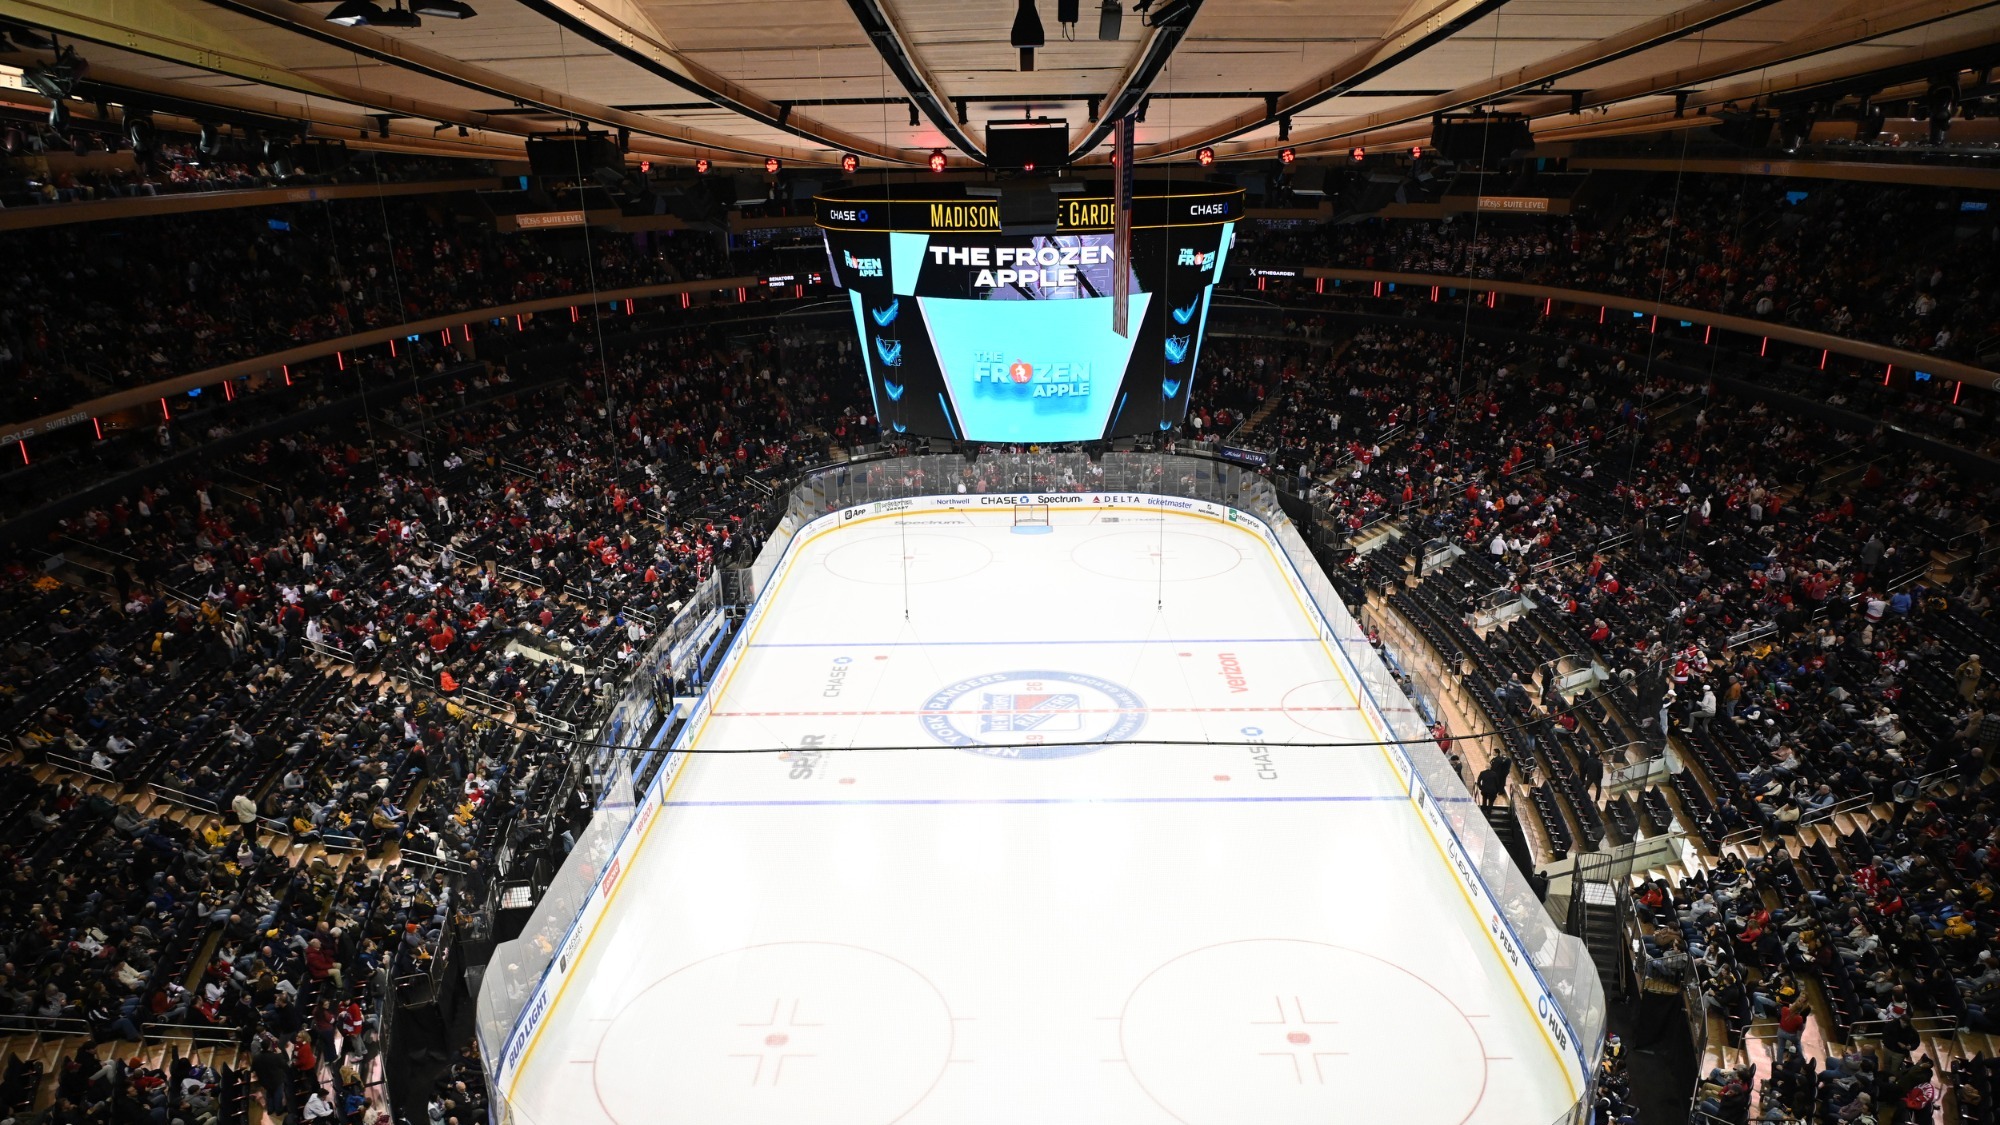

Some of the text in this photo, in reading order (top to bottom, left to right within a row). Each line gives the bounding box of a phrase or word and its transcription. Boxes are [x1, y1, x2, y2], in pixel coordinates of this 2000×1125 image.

[930, 203, 999, 228] MADISON
[1069, 201, 1115, 226] GARDE
[1190, 203, 1224, 216] CHASE
[1503, 200, 1523, 209] SUITE
[1524, 201, 1545, 209] LEVEL
[542, 215, 562, 224] SUITE
[563, 214, 583, 222] LEVEL
[830, 209, 857, 221] CHASE
[929, 246, 991, 266] THE
[973, 268, 1077, 288] APPLE
[974, 351, 1004, 363] THE
[1032, 383, 1090, 398] APPLE
[1245, 453, 1263, 462] ULTRA
[981, 497, 1018, 505] CHASE
[1037, 495, 1081, 504] Spectrum
[1147, 497, 1192, 508] ticketmaster
[1231, 511, 1260, 529] enterprise
[823, 665, 848, 698] CHASE
[1217, 653, 1249, 694] verizon
[929, 673, 1009, 710] RANGERS
[635, 801, 654, 836] verizon
[603, 864, 620, 892] Lenovo
[1454, 852, 1478, 897] LEXUS
[564, 923, 584, 957] CAESARS
[1499, 929, 1519, 967] PEPSI
[508, 990, 548, 1071] BUD LIGHT
[1548, 1012, 1567, 1051] HUB
